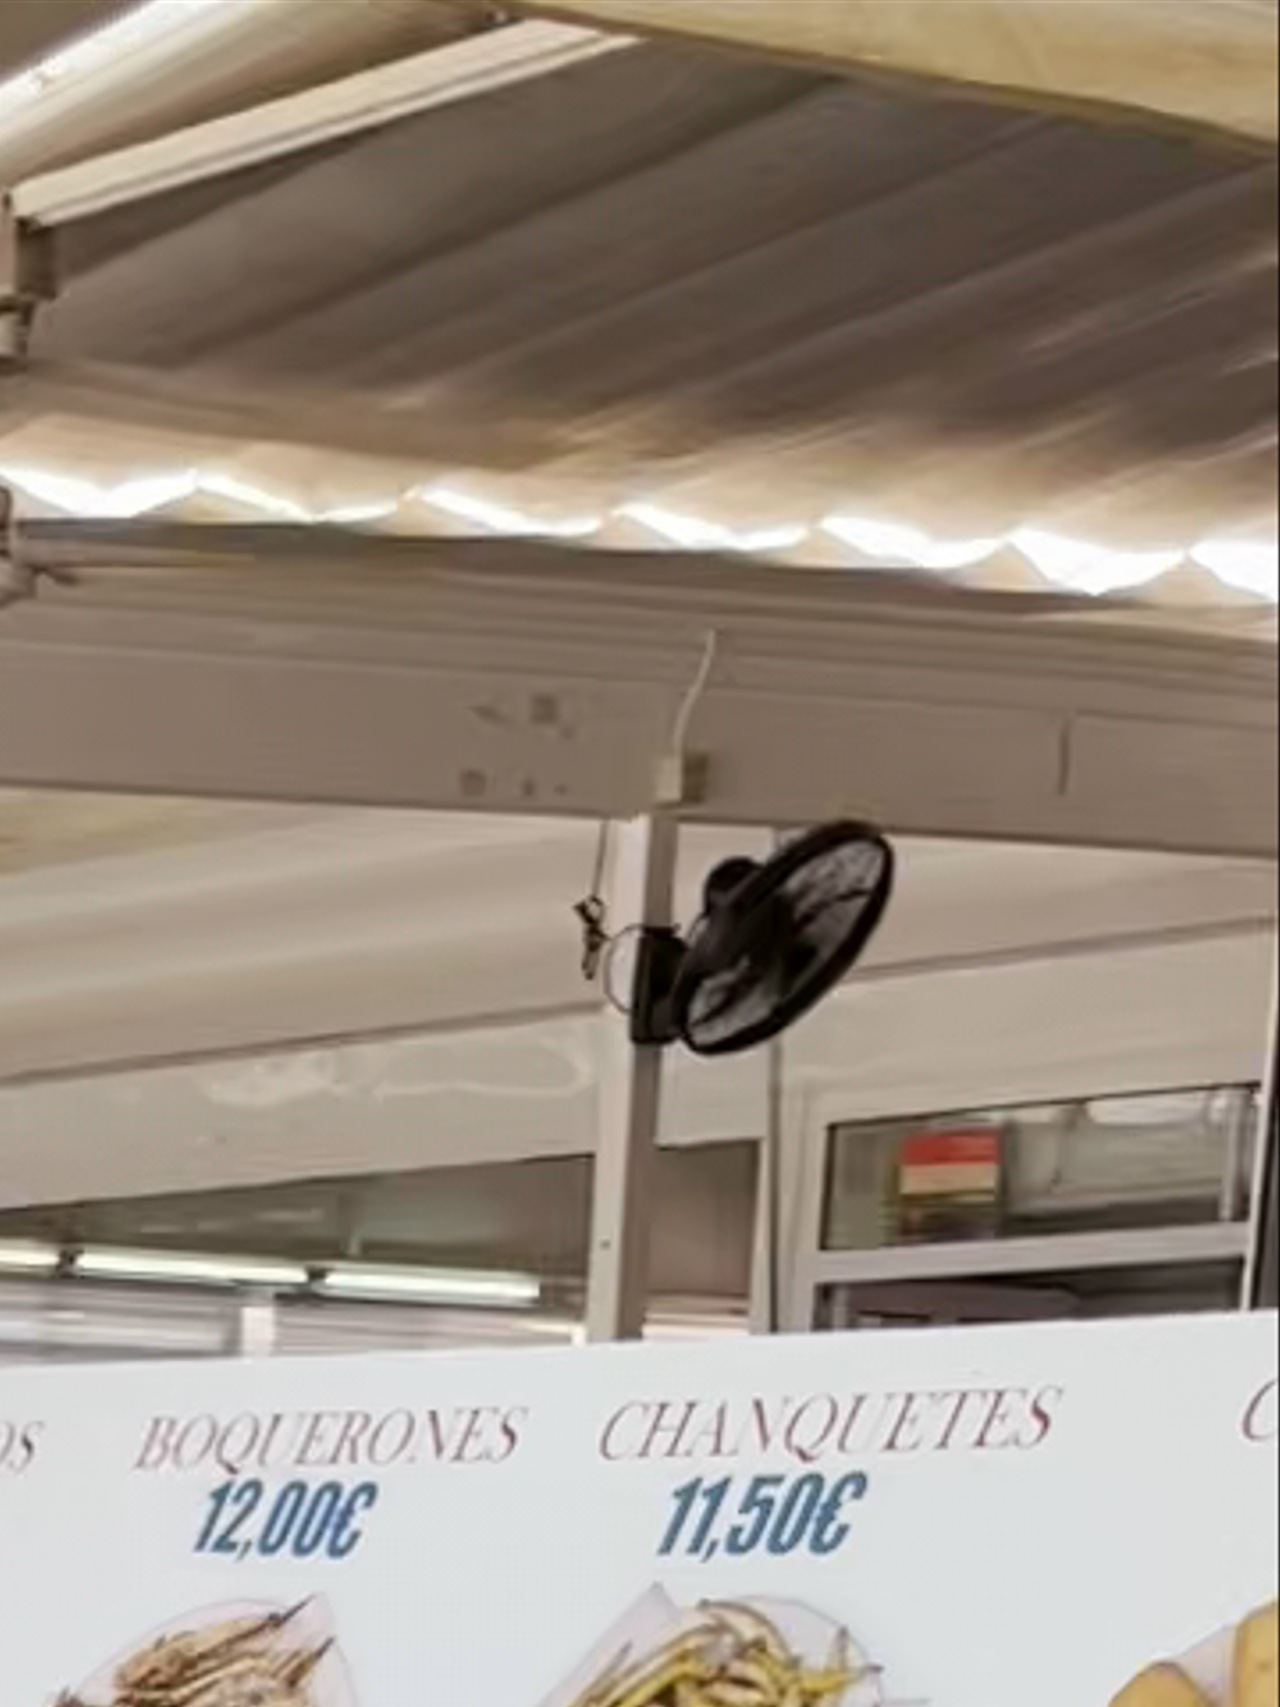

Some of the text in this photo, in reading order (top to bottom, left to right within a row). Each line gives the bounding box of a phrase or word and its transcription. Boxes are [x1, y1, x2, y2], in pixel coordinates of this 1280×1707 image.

[133, 1406, 528, 1475] BOQUERONES
[597, 1385, 1065, 1463] CHANQUETES
[194, 1479, 378, 1561] 12,00€
[656, 1471, 869, 1563] 11,50€
